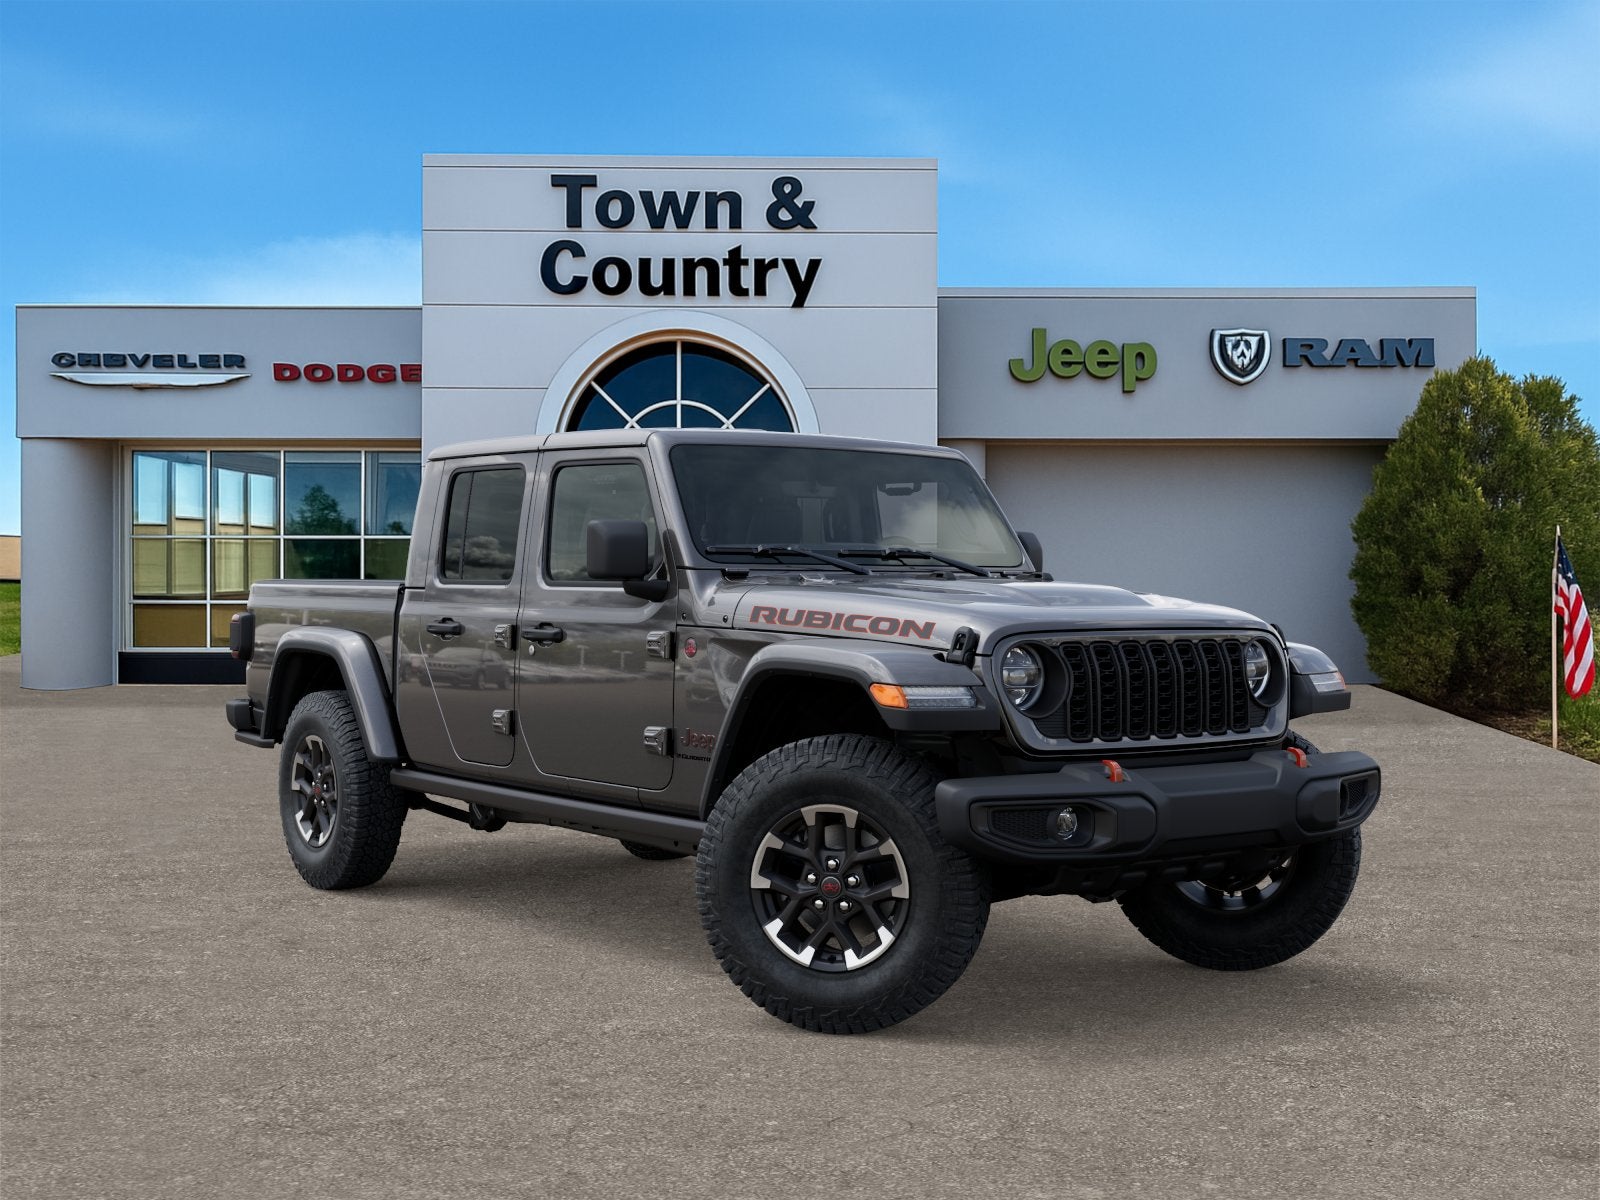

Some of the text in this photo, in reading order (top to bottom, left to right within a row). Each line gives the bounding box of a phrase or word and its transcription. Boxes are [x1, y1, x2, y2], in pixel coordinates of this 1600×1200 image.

[550, 174, 818, 230] Town &
[540, 239, 822, 308] Country
[273, 363, 422, 383] DODGE
[1008, 328, 1158, 393] Jeep
[1282, 337, 1436, 368] RAM
[749, 605, 936, 640] RUBICON
